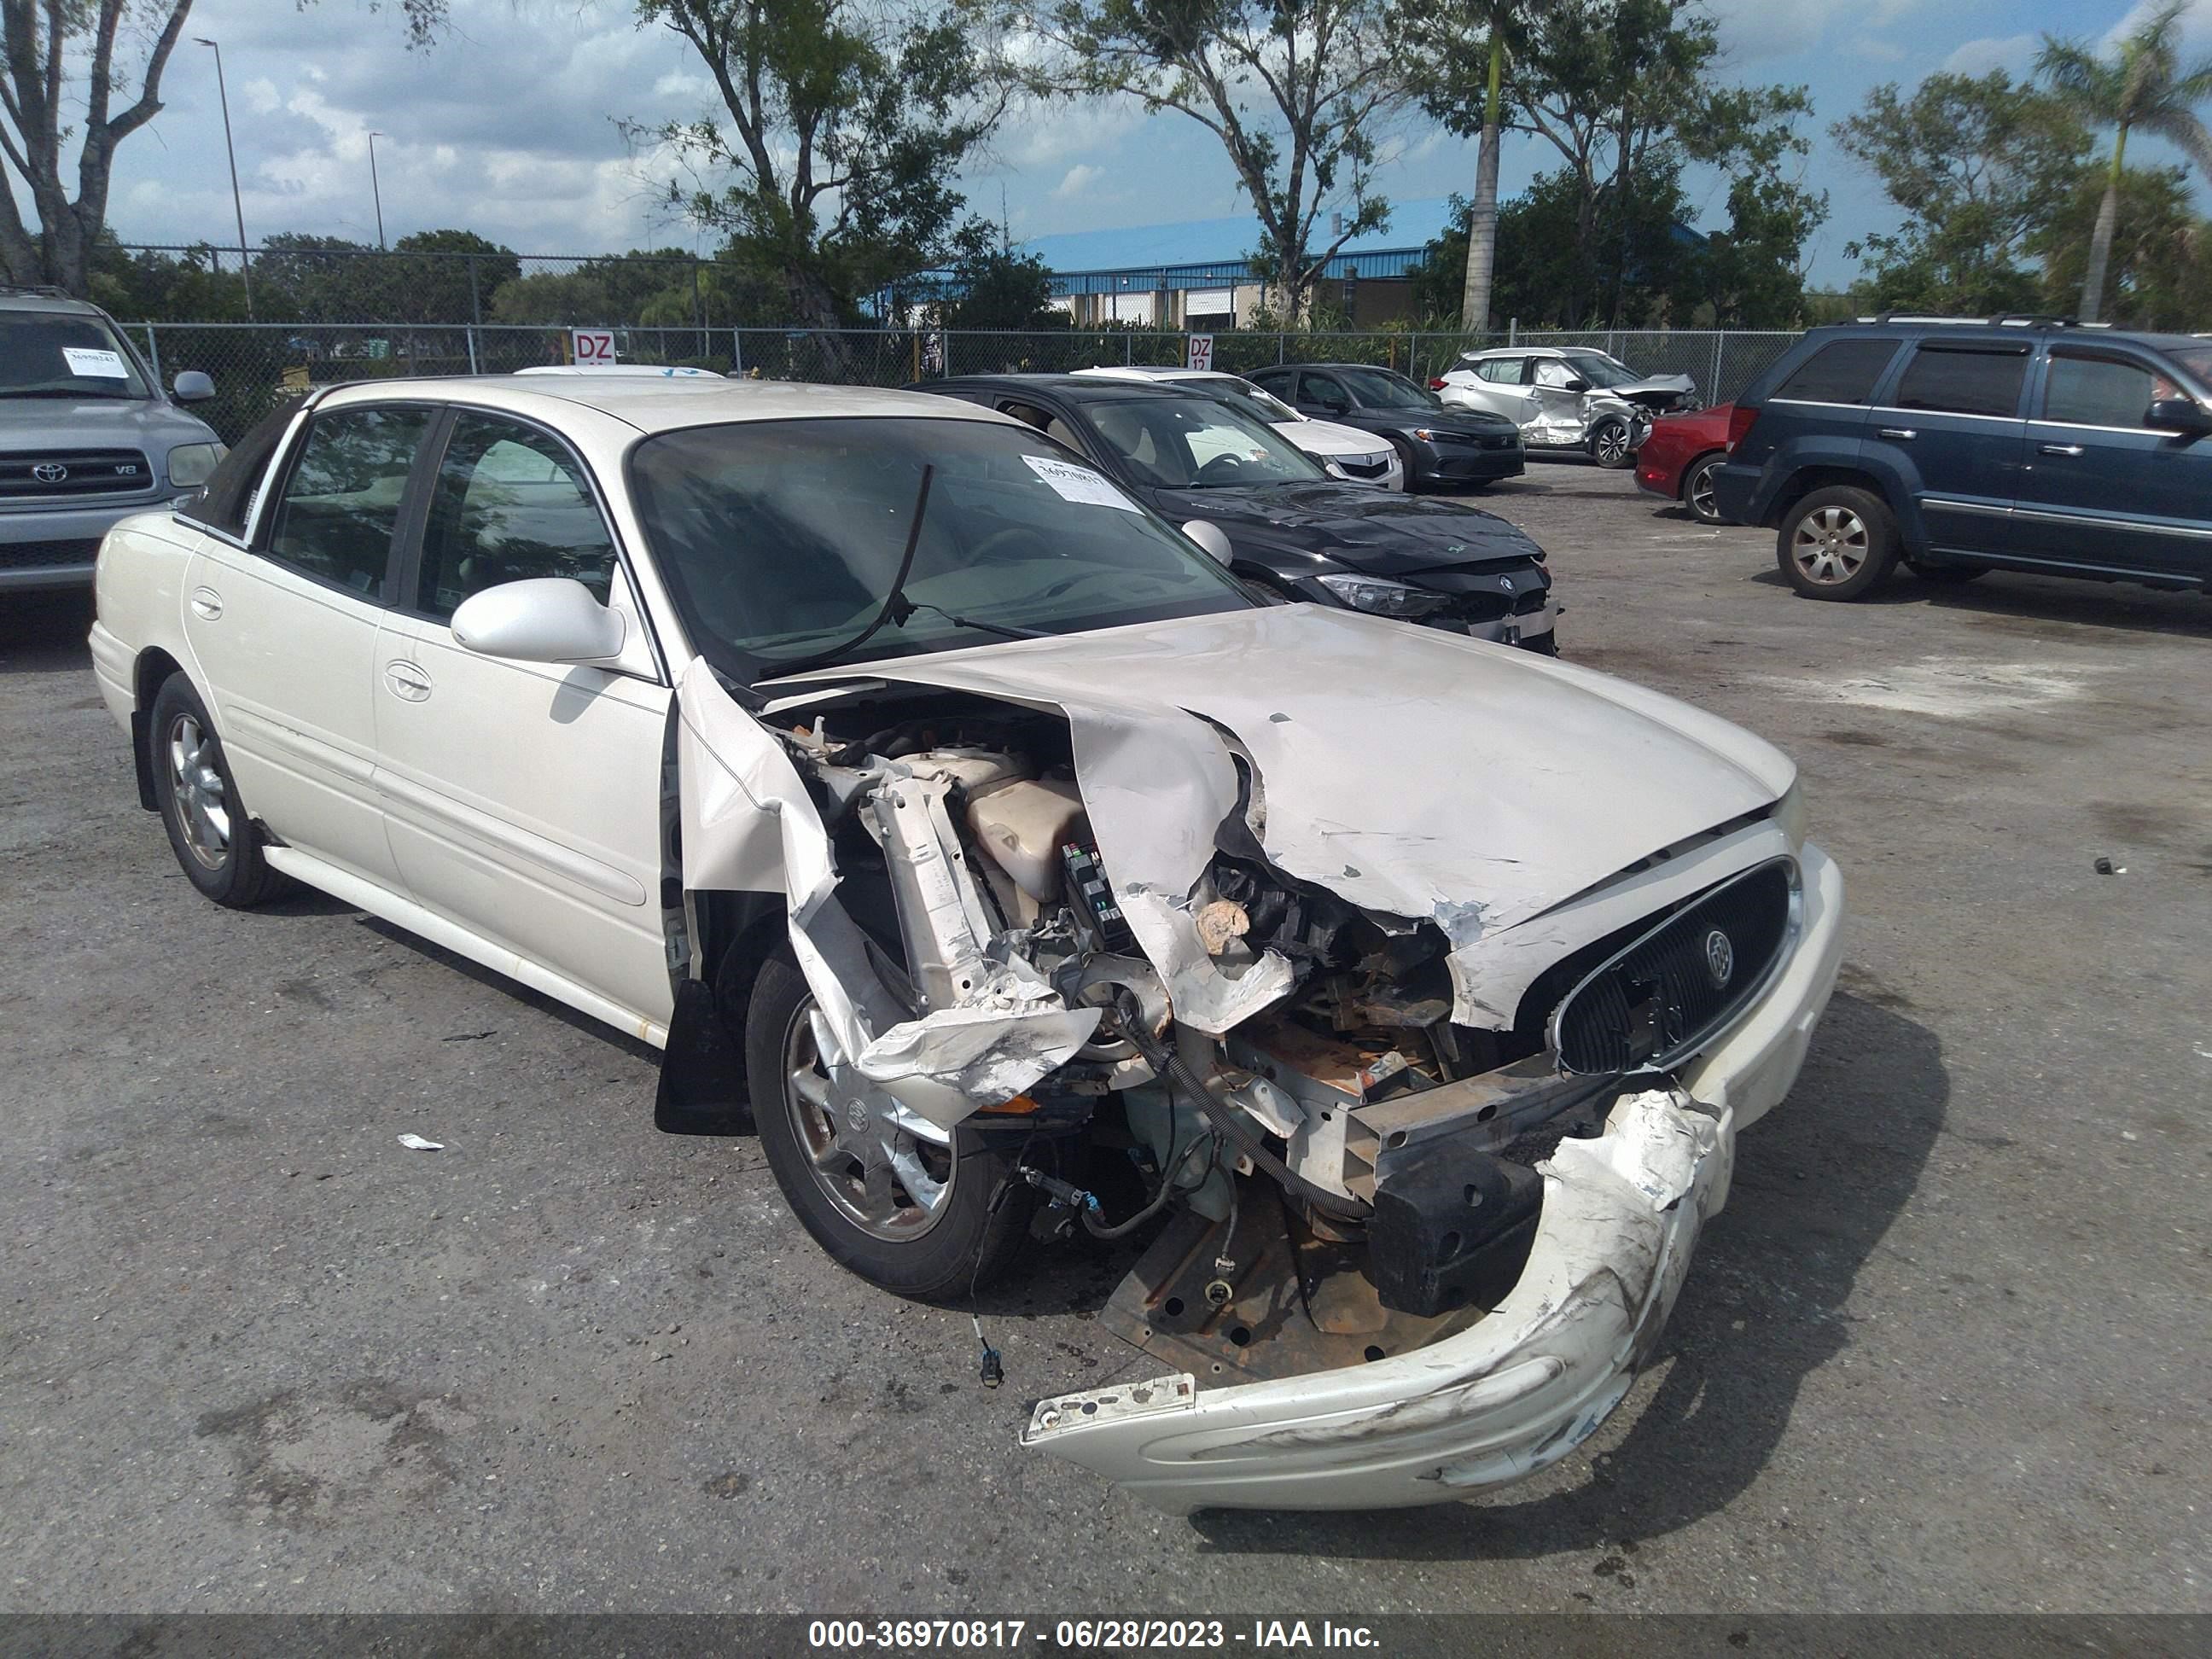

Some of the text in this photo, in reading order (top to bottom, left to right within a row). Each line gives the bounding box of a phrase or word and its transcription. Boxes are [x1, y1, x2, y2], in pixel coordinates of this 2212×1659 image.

[577, 335, 612, 358] DZ
[1190, 338, 1211, 357] DZ
[115, 465, 137, 474] V8
